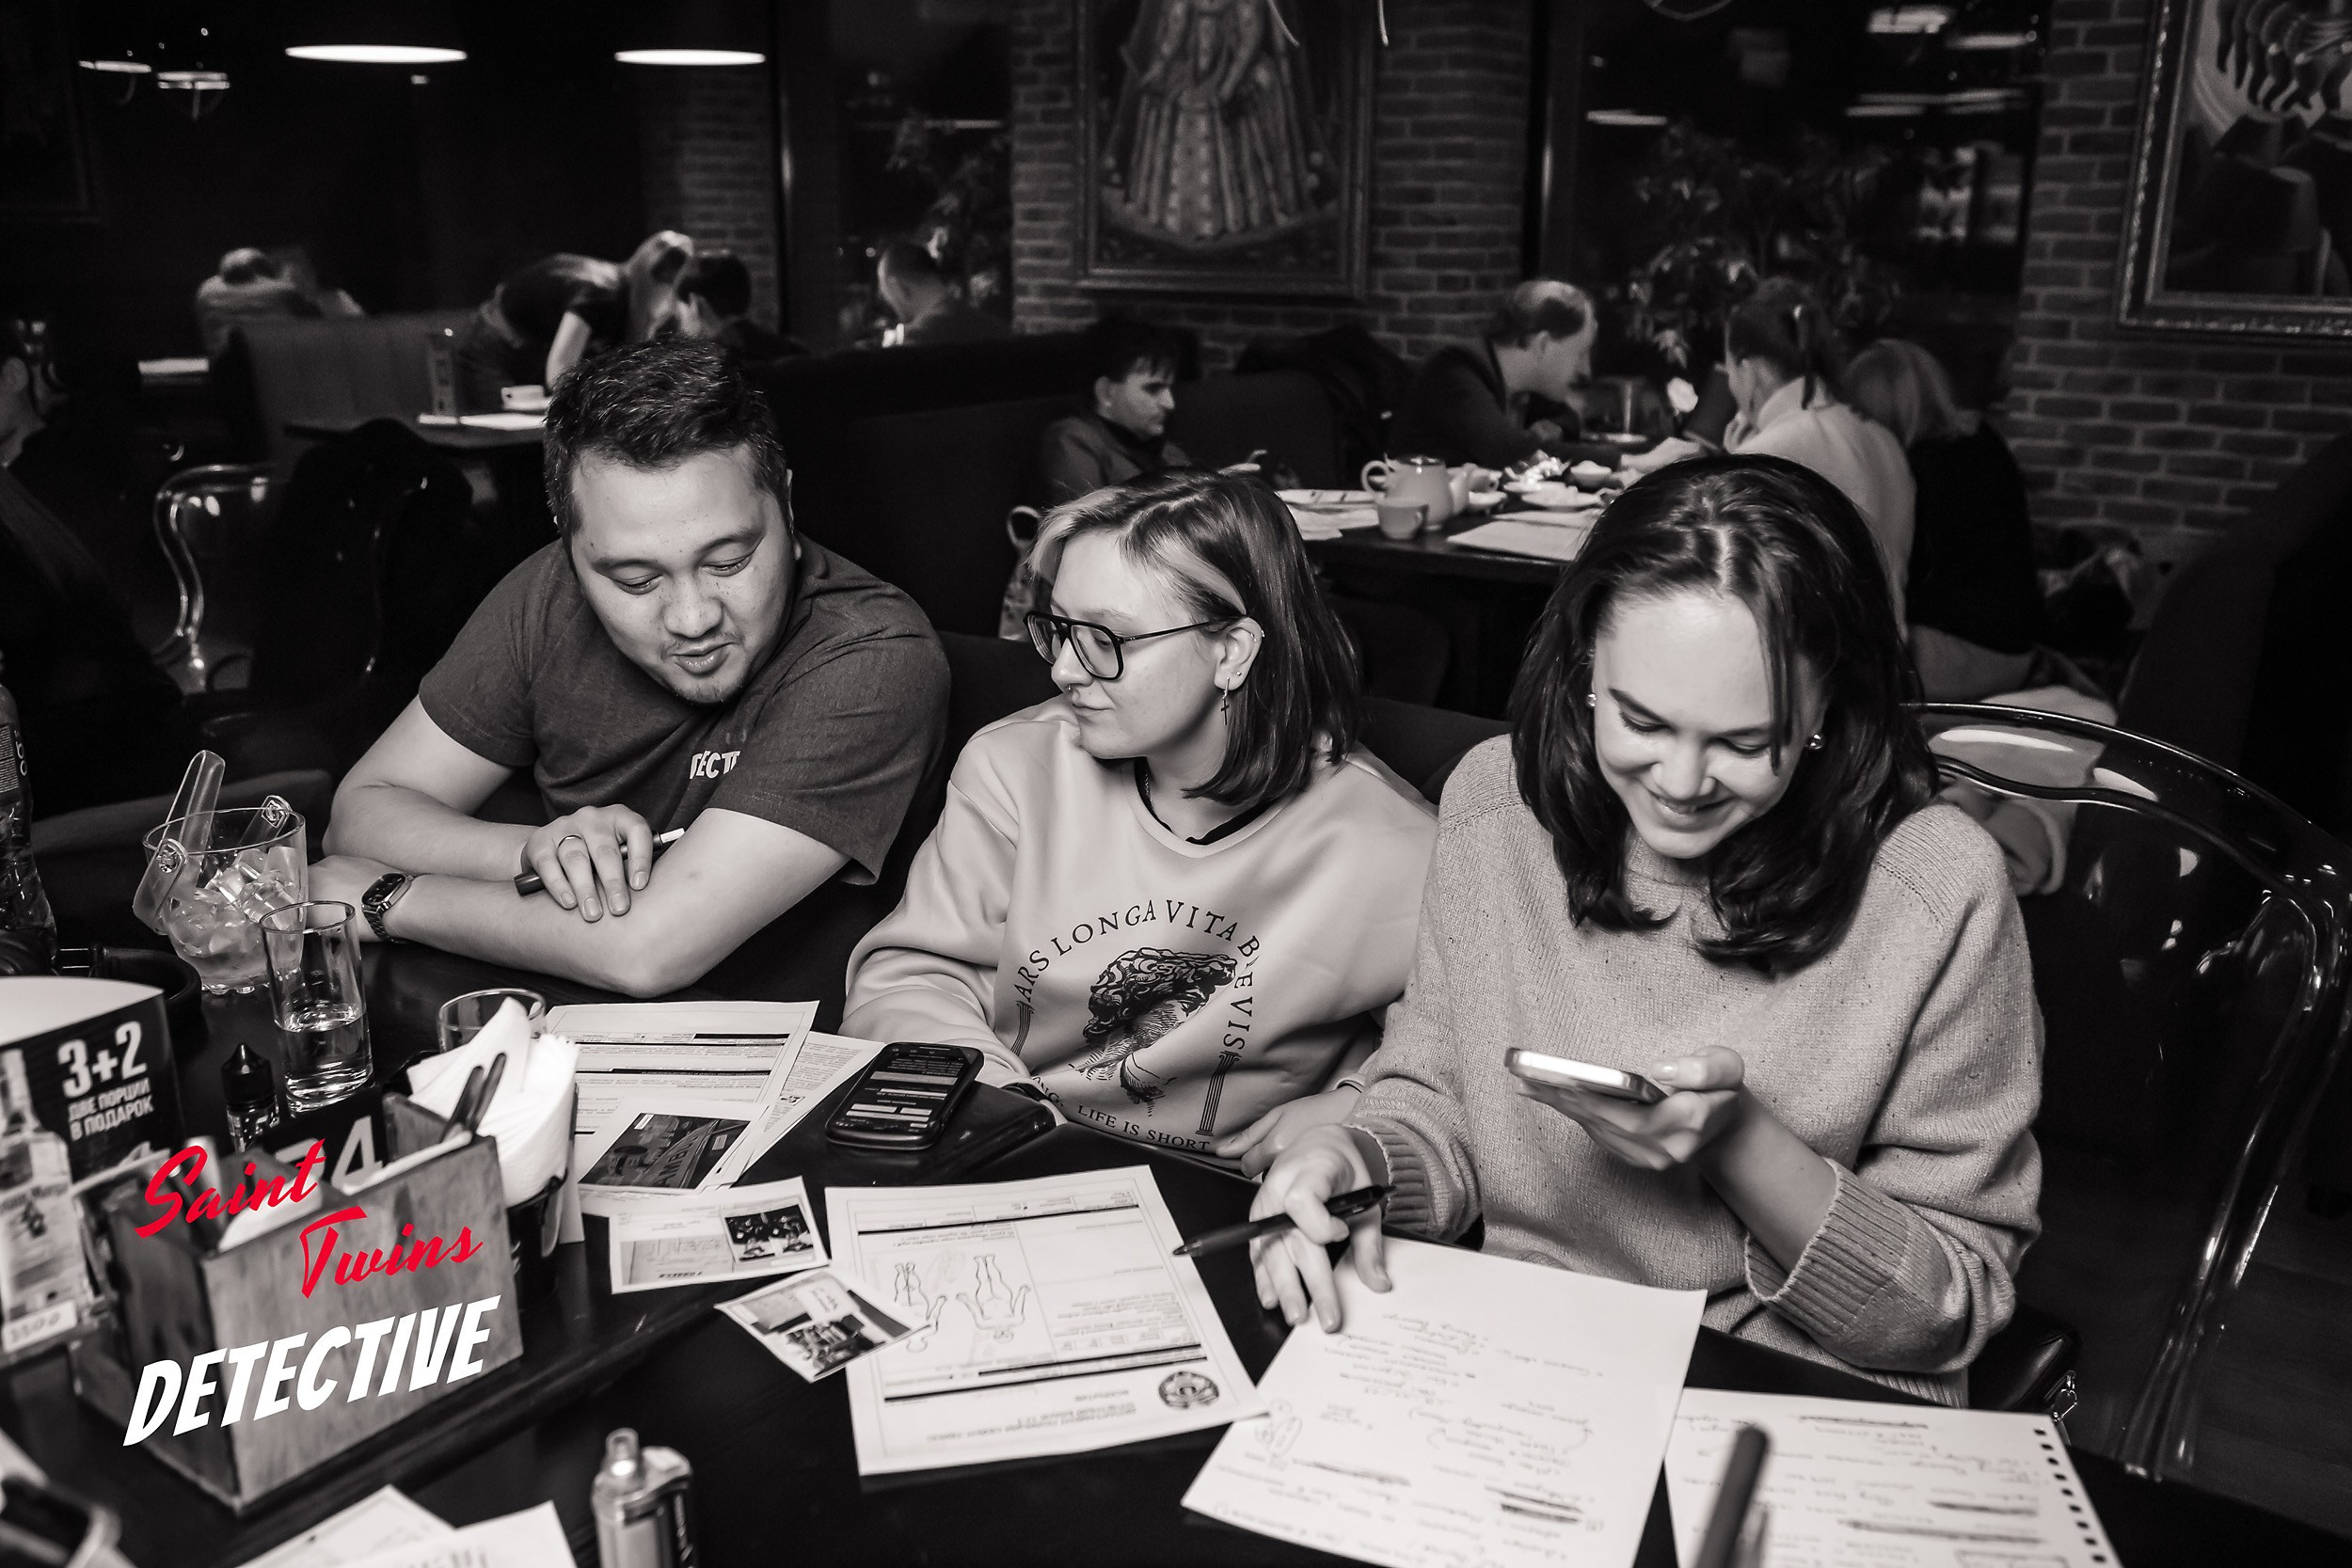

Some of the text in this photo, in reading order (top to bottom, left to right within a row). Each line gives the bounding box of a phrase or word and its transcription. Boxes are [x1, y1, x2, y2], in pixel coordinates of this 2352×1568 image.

[1013, 950, 1050, 1003] ARS
[1050, 899, 1157, 957] LONGA
[1166, 899, 1238, 942] VITA
[57, 1021, 148, 1099] 3+2
[68, 1078, 151, 1122] ДВЕ ПОРЦИИ
[70, 1095, 154, 1142] В ПОДАРОК
[1077, 1104, 1118, 1129] LIFE
[1123, 1121, 1140, 1136] IS
[1146, 1130, 1211, 1150] SHORT
